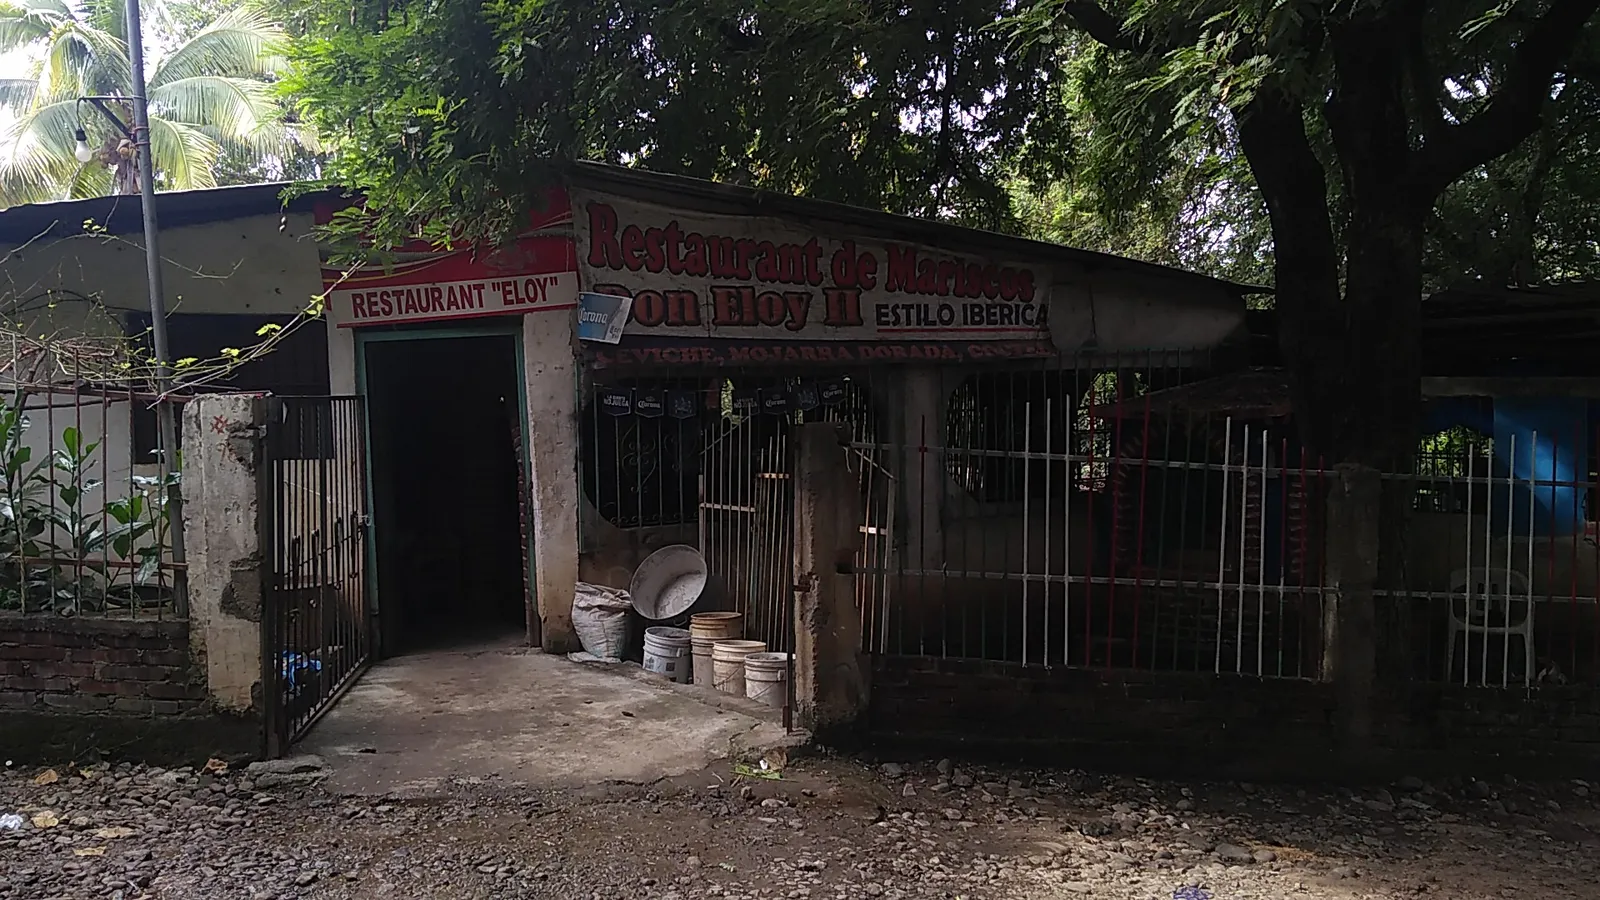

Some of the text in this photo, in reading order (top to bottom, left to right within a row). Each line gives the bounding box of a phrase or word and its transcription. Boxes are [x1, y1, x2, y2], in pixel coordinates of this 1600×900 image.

[587, 203, 1035, 303] Restaurant de Mariscos
[351, 276, 559, 319] RESTAURANT "ELOY"
[710, 285, 813, 331] Eloy
[823, 287, 863, 327] II
[578, 307, 608, 326] Corona
[876, 303, 1047, 327] ESTILO IBERICA
[729, 346, 854, 362] MOJARRA
[859, 344, 964, 363] DORADA,
